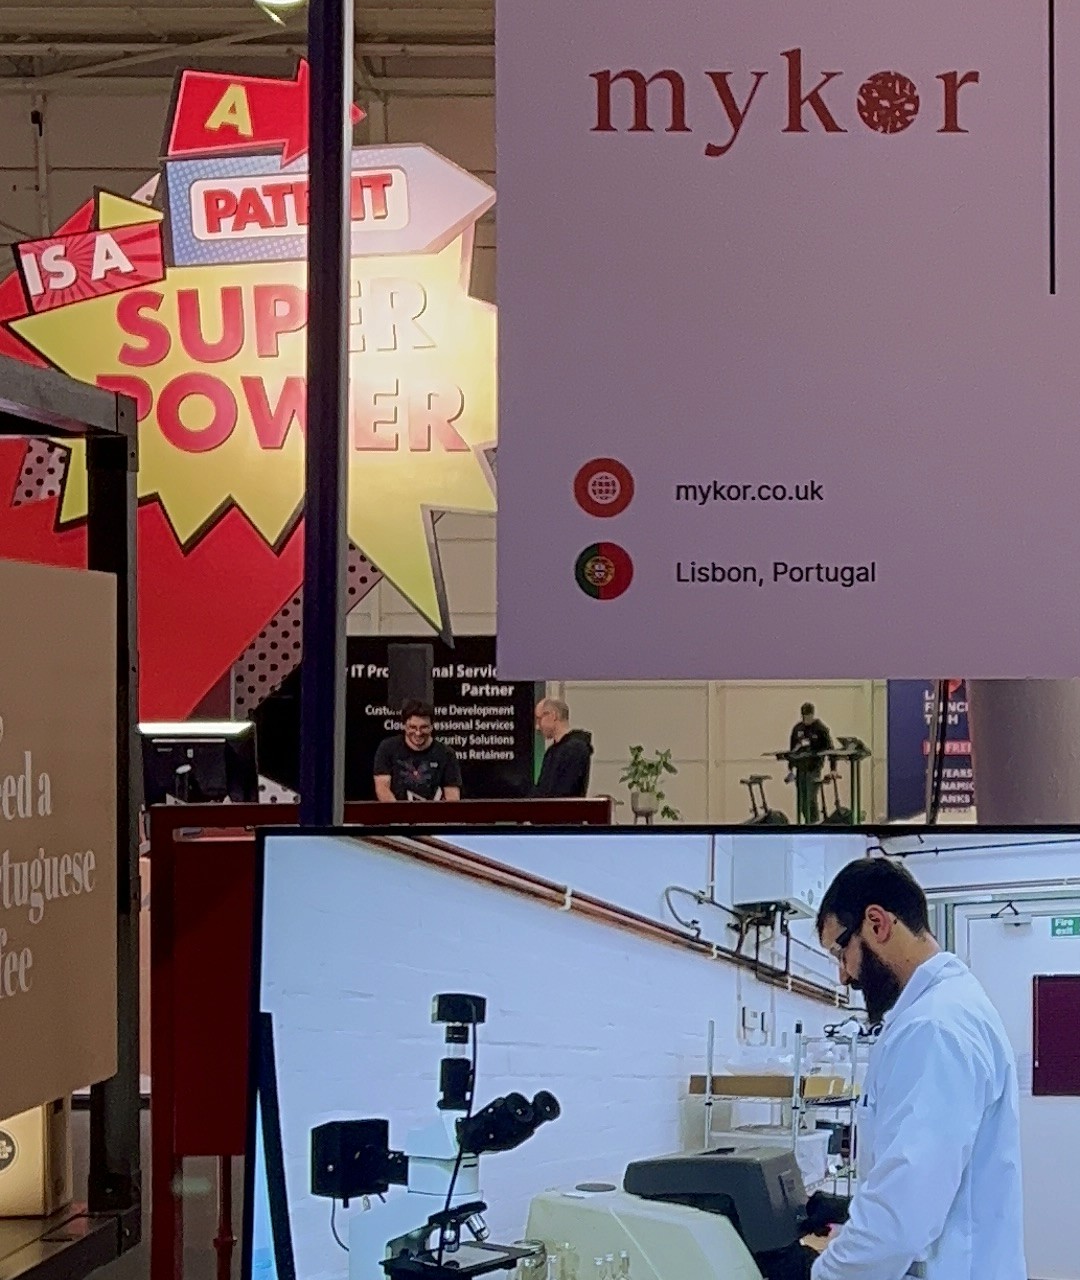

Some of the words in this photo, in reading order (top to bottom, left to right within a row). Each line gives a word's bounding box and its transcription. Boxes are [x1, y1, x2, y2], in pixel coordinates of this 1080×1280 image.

[204, 83, 253, 138] A
[589, 48, 979, 157] mykor
[22, 244, 77, 296] IS
[92, 233, 137, 281] A
[676, 481, 823, 505] mykor.co.uk
[677, 562, 763, 587] Lisbon,
[774, 562, 875, 587] Portugal
[351, 665, 365, 678] IT
[457, 665, 497, 678] Servic
[462, 683, 514, 696] Partner
[450, 705, 514, 716] Development
[475, 720, 514, 730] Services
[469, 735, 514, 745] Solutions
[469, 749, 514, 760] Retainers
[38, 772, 52, 816] a
